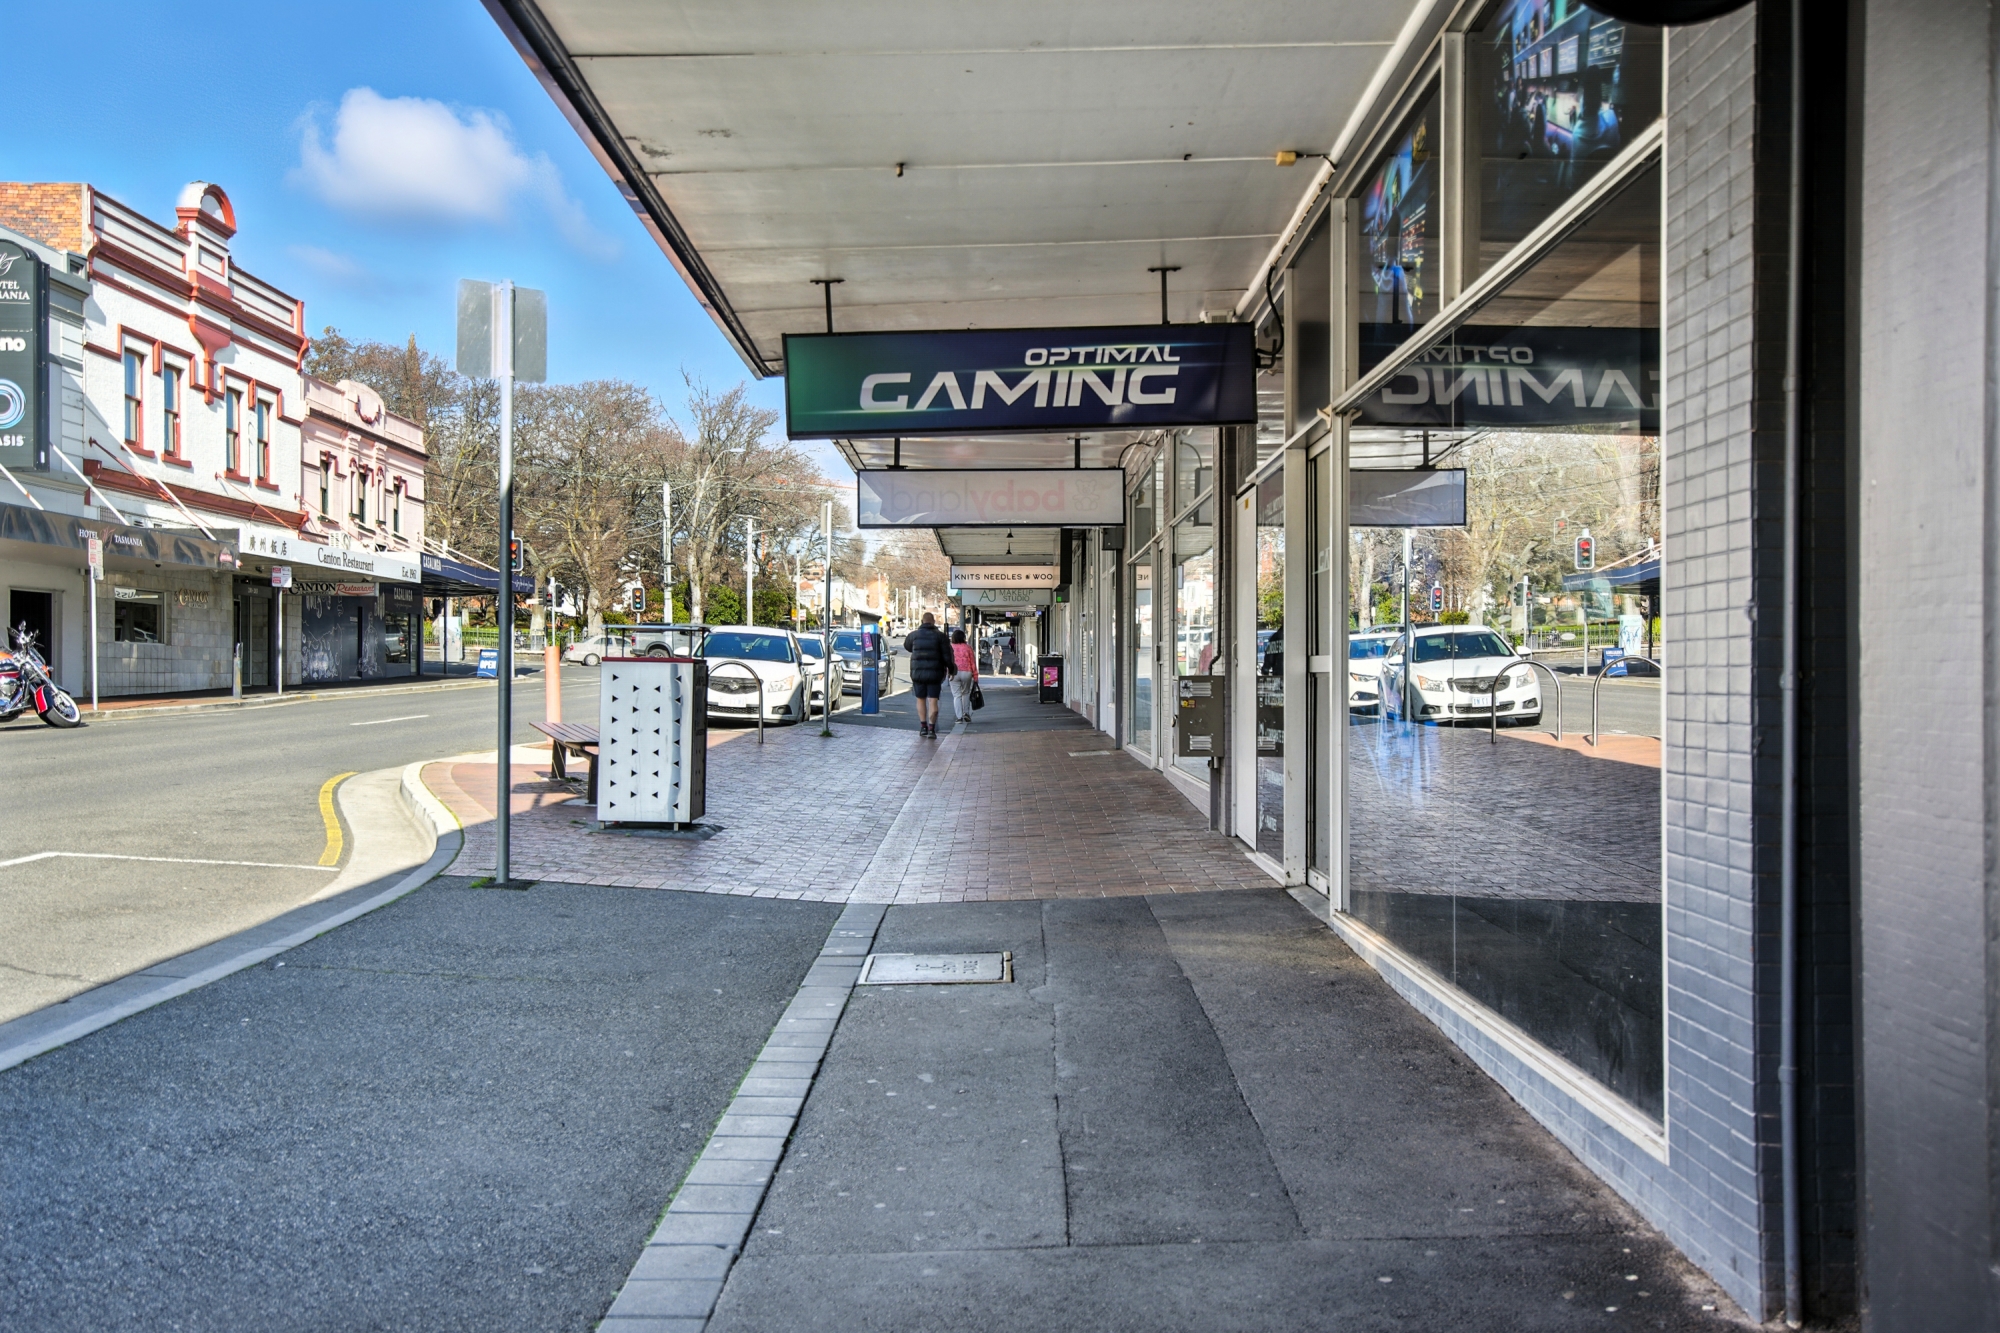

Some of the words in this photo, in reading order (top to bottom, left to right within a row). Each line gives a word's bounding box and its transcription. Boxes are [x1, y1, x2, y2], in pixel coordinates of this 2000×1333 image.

[0, 280, 20, 290] TEL
[0, 337, 27, 352] no
[1024, 344, 1181, 366] OPTIMAL
[859, 365, 1179, 411] GAMING
[0, 434, 25, 447] SIS
[79, 528, 99, 540] HOTEL
[114, 534, 143, 547] TASMANIA
[317, 547, 341, 567] Canton
[342, 551, 375, 573] Restaurant
[288, 582, 336, 595] CANTON
[334, 582, 375, 597] Restaurant
